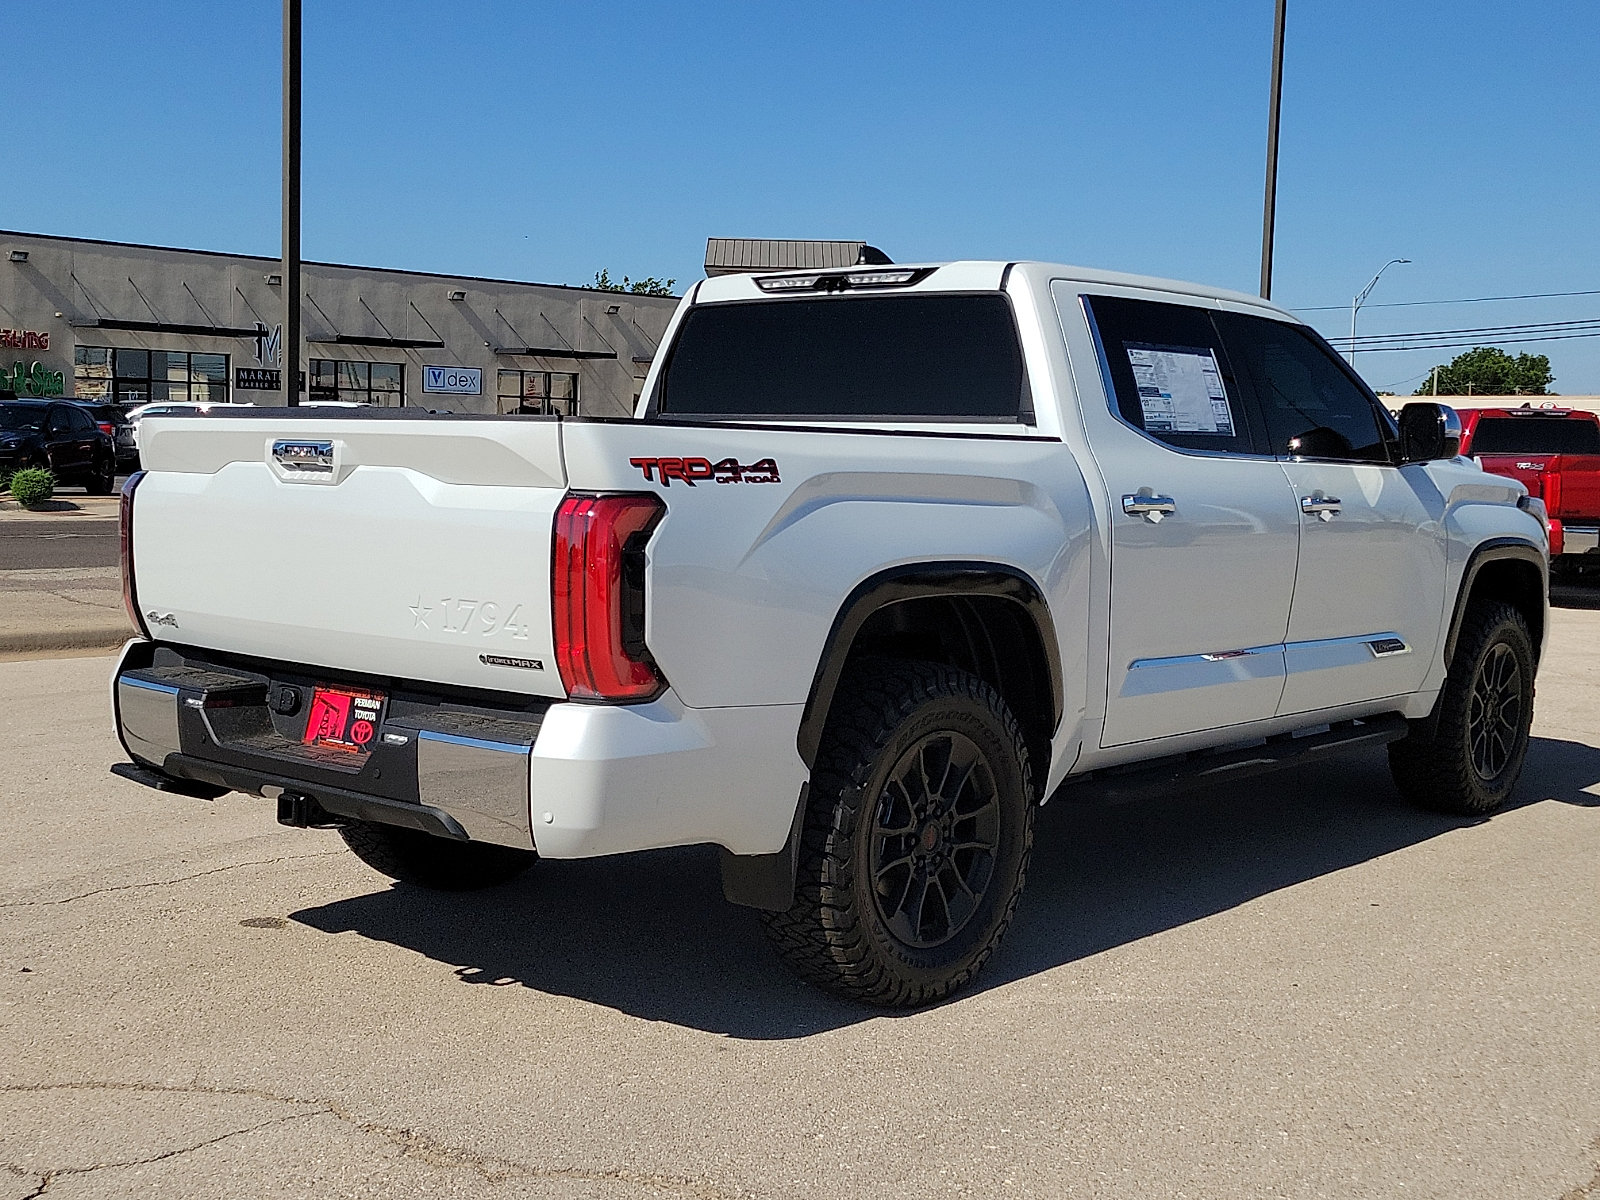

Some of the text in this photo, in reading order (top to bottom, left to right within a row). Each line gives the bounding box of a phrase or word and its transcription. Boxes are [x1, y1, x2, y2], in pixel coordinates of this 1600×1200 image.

[31, 361, 65, 396] Spa
[447, 371, 476, 387] dex
[629, 457, 716, 487] TRD
[715, 475, 782, 484] OFF ROAD
[440, 598, 528, 640] 1794
[512, 658, 541, 669] MAX
[354, 697, 381, 710] PERMIAN
[354, 709, 377, 722] TOYOTA
